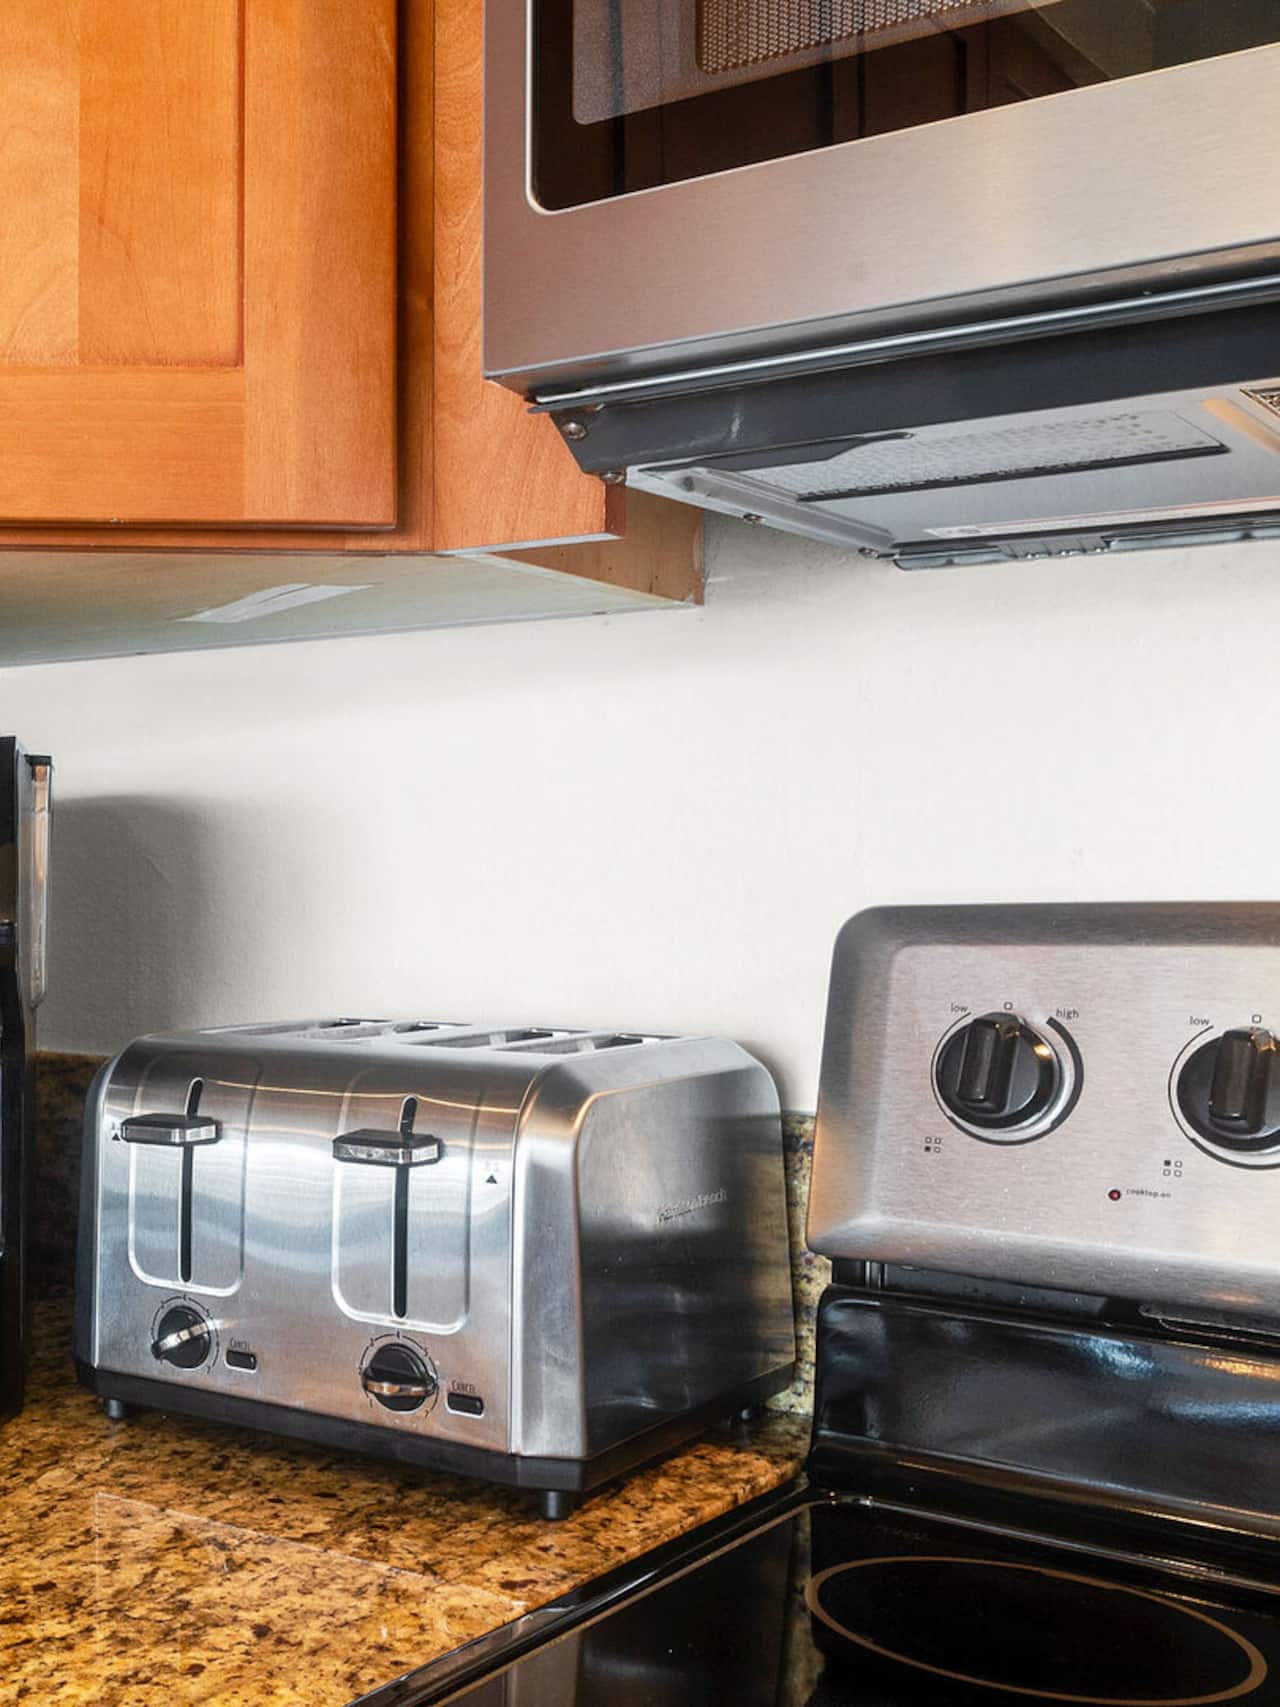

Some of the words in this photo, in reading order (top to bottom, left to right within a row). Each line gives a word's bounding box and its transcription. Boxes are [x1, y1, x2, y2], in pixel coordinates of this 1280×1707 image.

[950, 1003, 968, 1013] low
[1055, 1008, 1080, 1020] high
[1189, 1015, 1210, 1026] low
